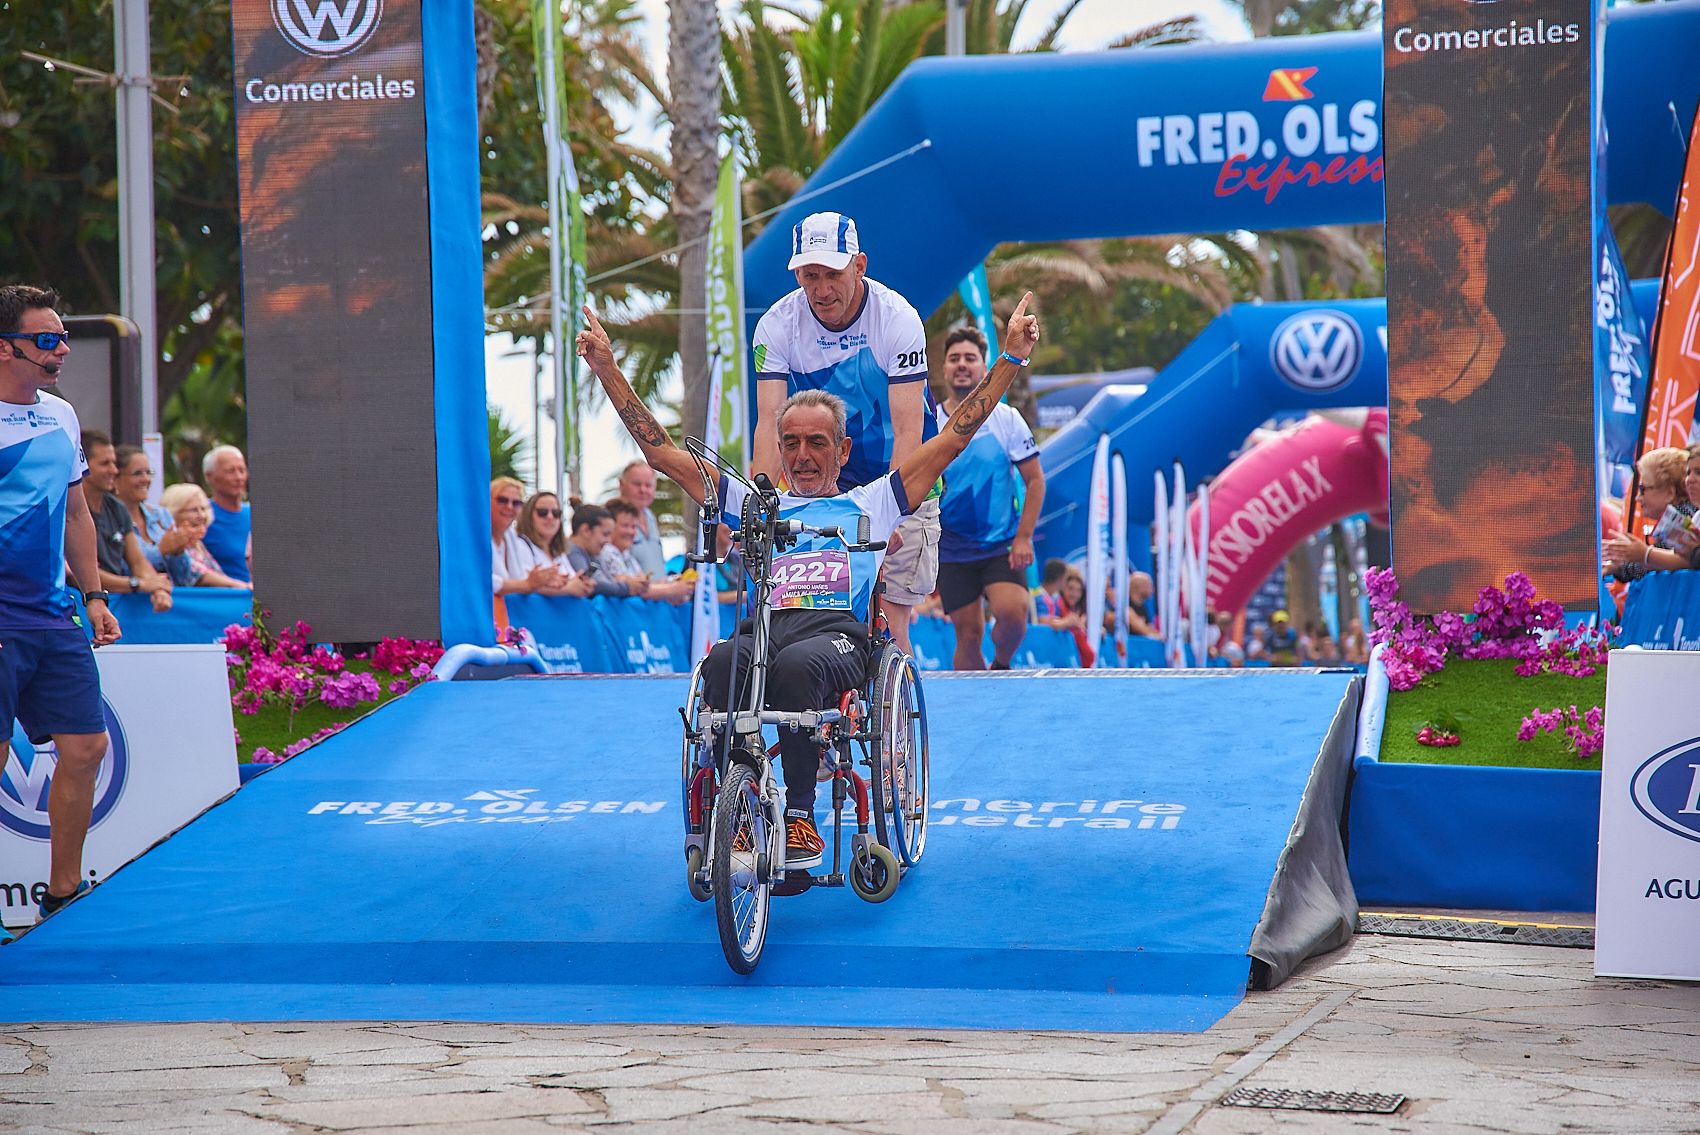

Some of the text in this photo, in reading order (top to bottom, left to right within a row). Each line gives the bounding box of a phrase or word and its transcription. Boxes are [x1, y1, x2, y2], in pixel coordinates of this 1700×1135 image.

[1394, 19, 1580, 52] Comerciales
[245, 74, 417, 103] Comerciales
[1207, 456, 1333, 602] HYSIORELAX
[773, 561, 844, 585] 4227
[307, 801, 668, 815] FRED. OLSEN
